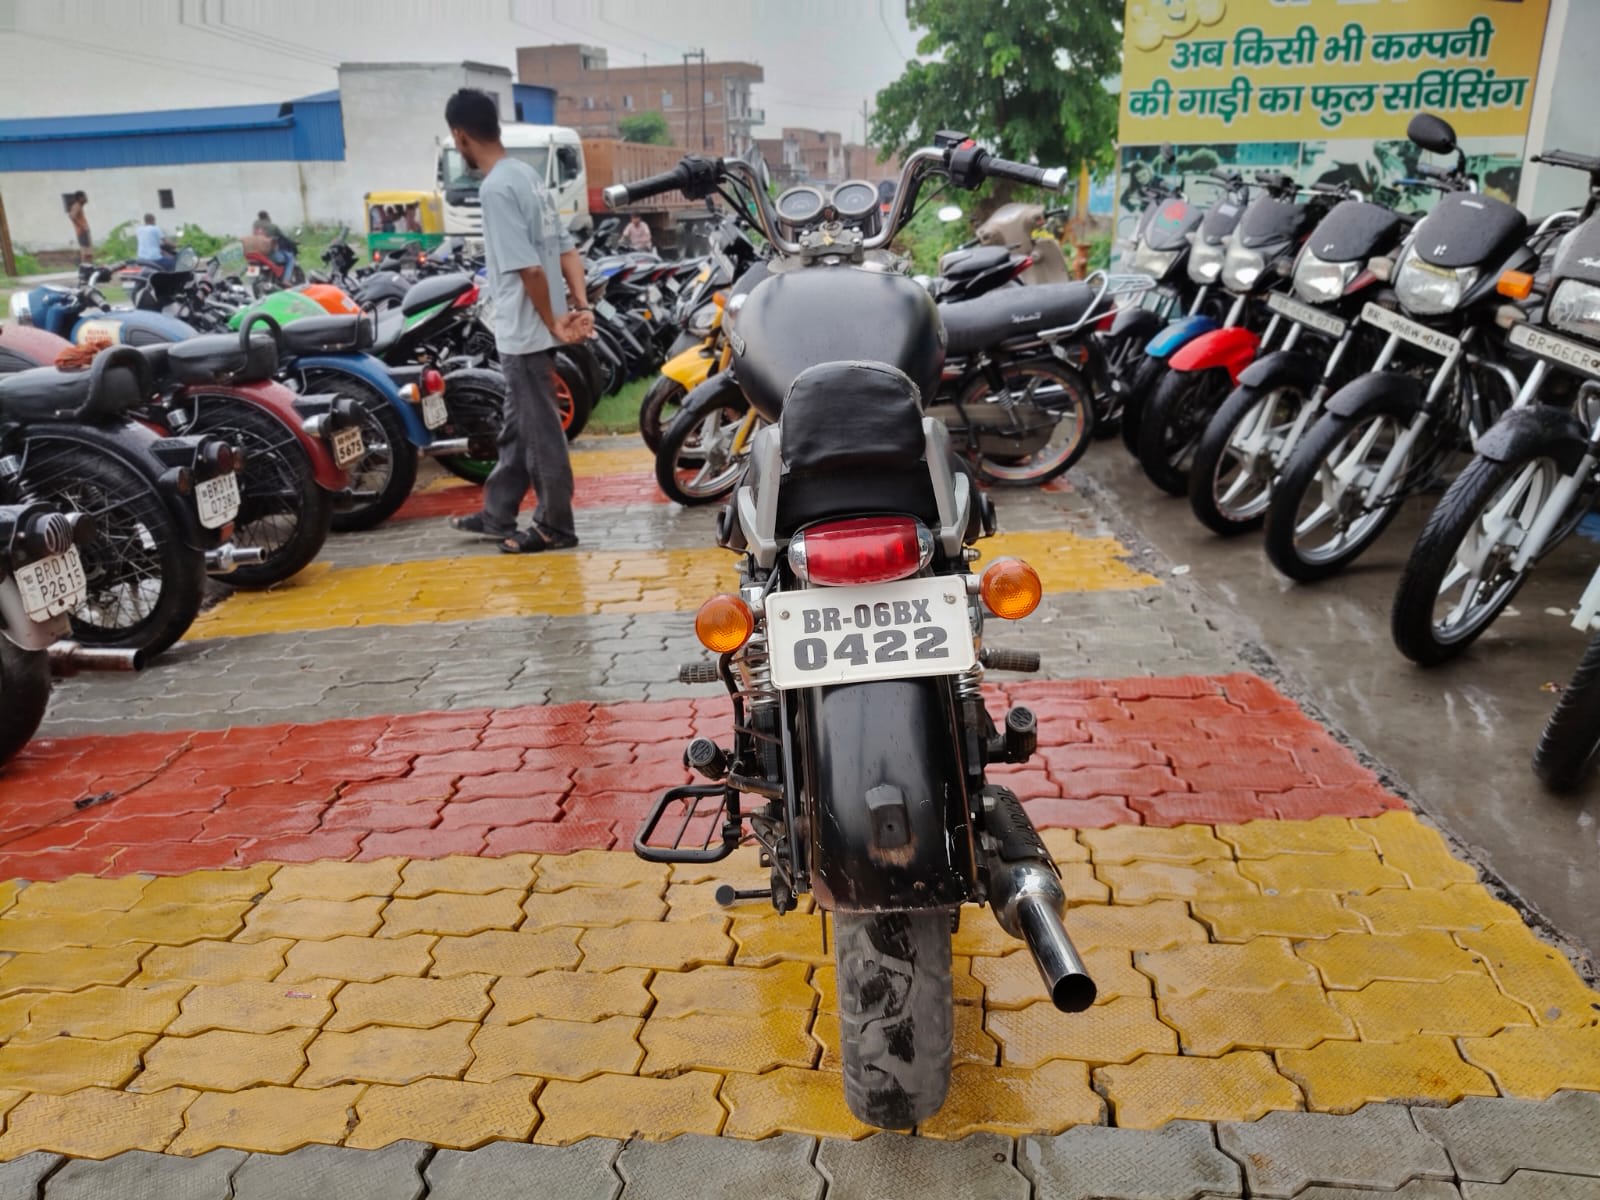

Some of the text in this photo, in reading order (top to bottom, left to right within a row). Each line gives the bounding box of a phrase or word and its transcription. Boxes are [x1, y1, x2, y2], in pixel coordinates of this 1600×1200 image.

[1170, 16, 1495, 69] अब किसी भी कम्पनी
[1128, 68, 1530, 127] की गाड़ी का फुल सर्विसिंग
[803, 598, 932, 634] BR-06BX
[793, 626, 950, 672] 0422
